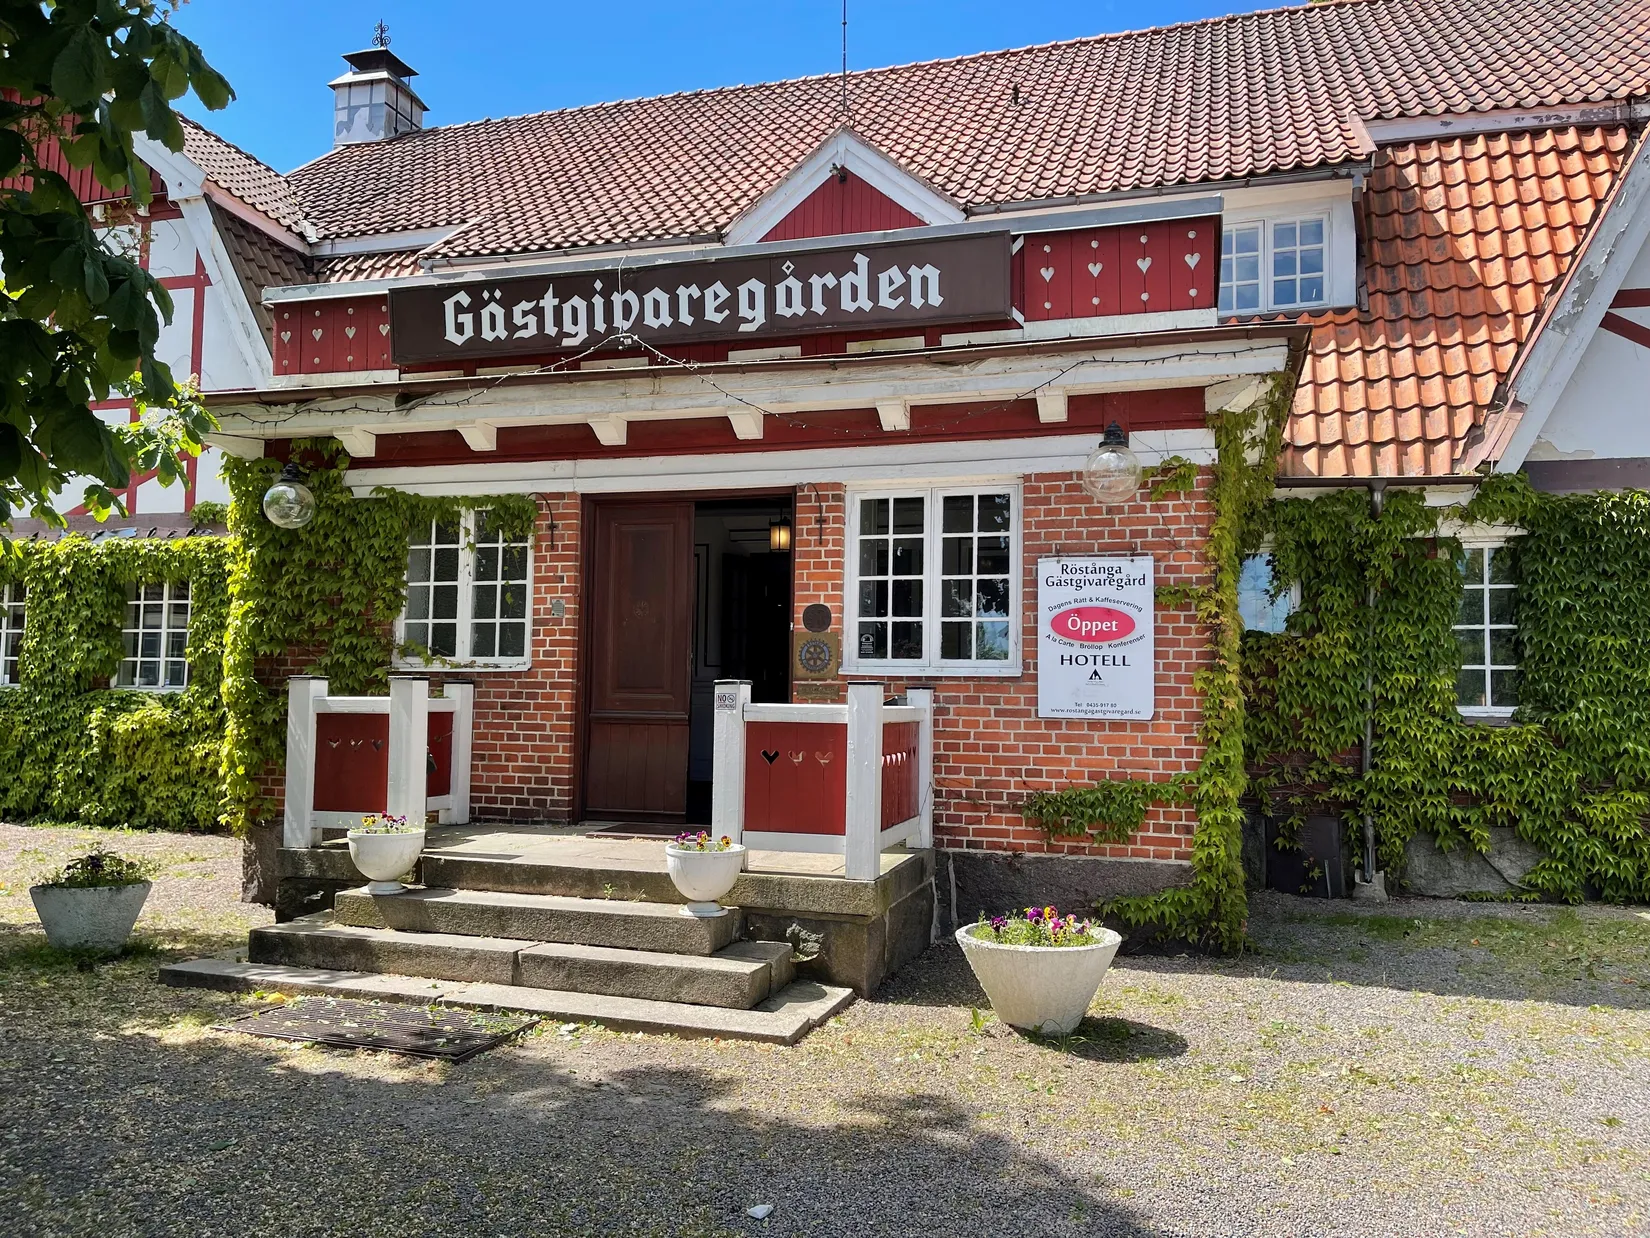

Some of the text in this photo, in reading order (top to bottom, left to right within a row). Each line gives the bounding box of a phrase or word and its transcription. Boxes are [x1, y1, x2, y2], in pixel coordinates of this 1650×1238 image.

[443, 252, 945, 347] Gästgivaregården
[1061, 562, 1122, 579] Röstånga
[1045, 574, 1146, 591] Gästgivaregård
[1048, 600, 1072, 612] Dagens
[1095, 596, 1143, 613] Kaffeservering
[1067, 613, 1119, 636] Öppet
[1058, 639, 1075, 648] Carte
[1108, 633, 1146, 649] Konferenser
[1060, 654, 1131, 667] HOTELL
